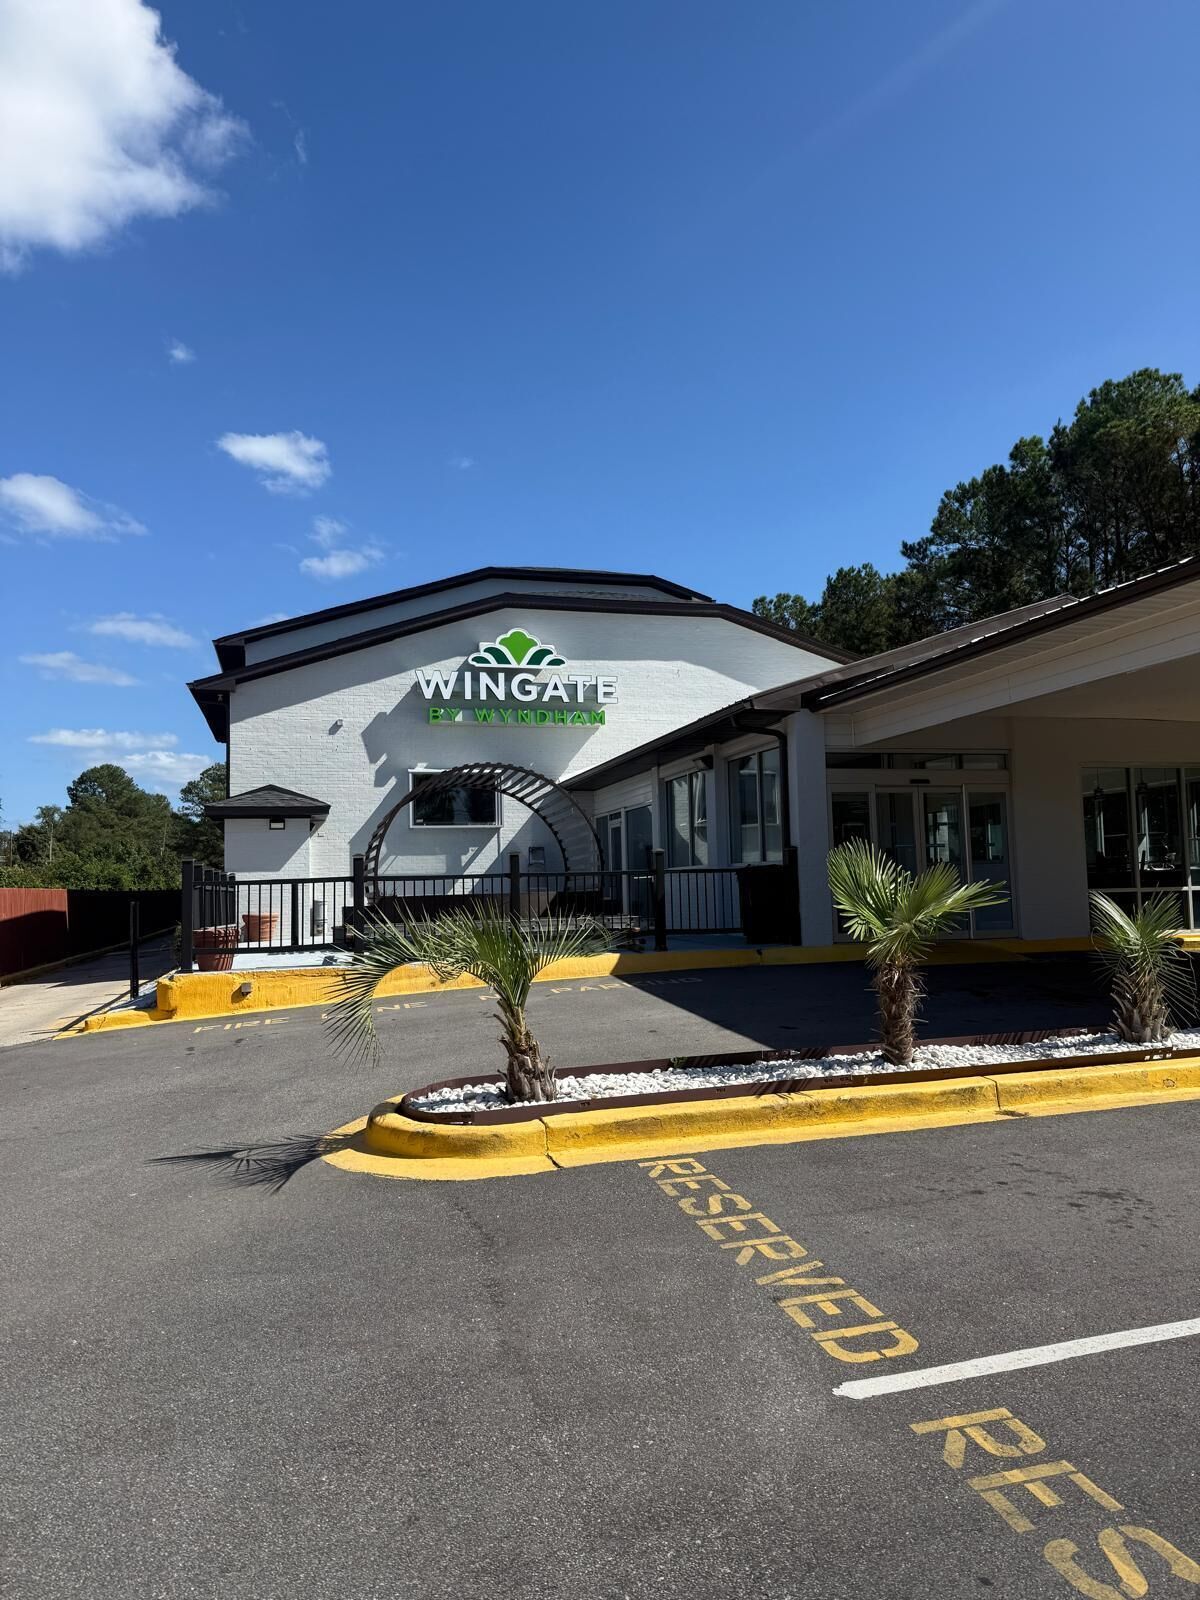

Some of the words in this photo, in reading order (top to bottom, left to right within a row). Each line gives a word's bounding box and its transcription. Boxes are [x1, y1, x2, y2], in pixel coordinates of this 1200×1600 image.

[415, 669, 619, 704] WINGATE
[429, 707, 460, 725] BY
[475, 707, 607, 726] WYNDHAM
[193, 1017, 289, 1034] FIRE
[638, 1157, 920, 1364] RESERVED
